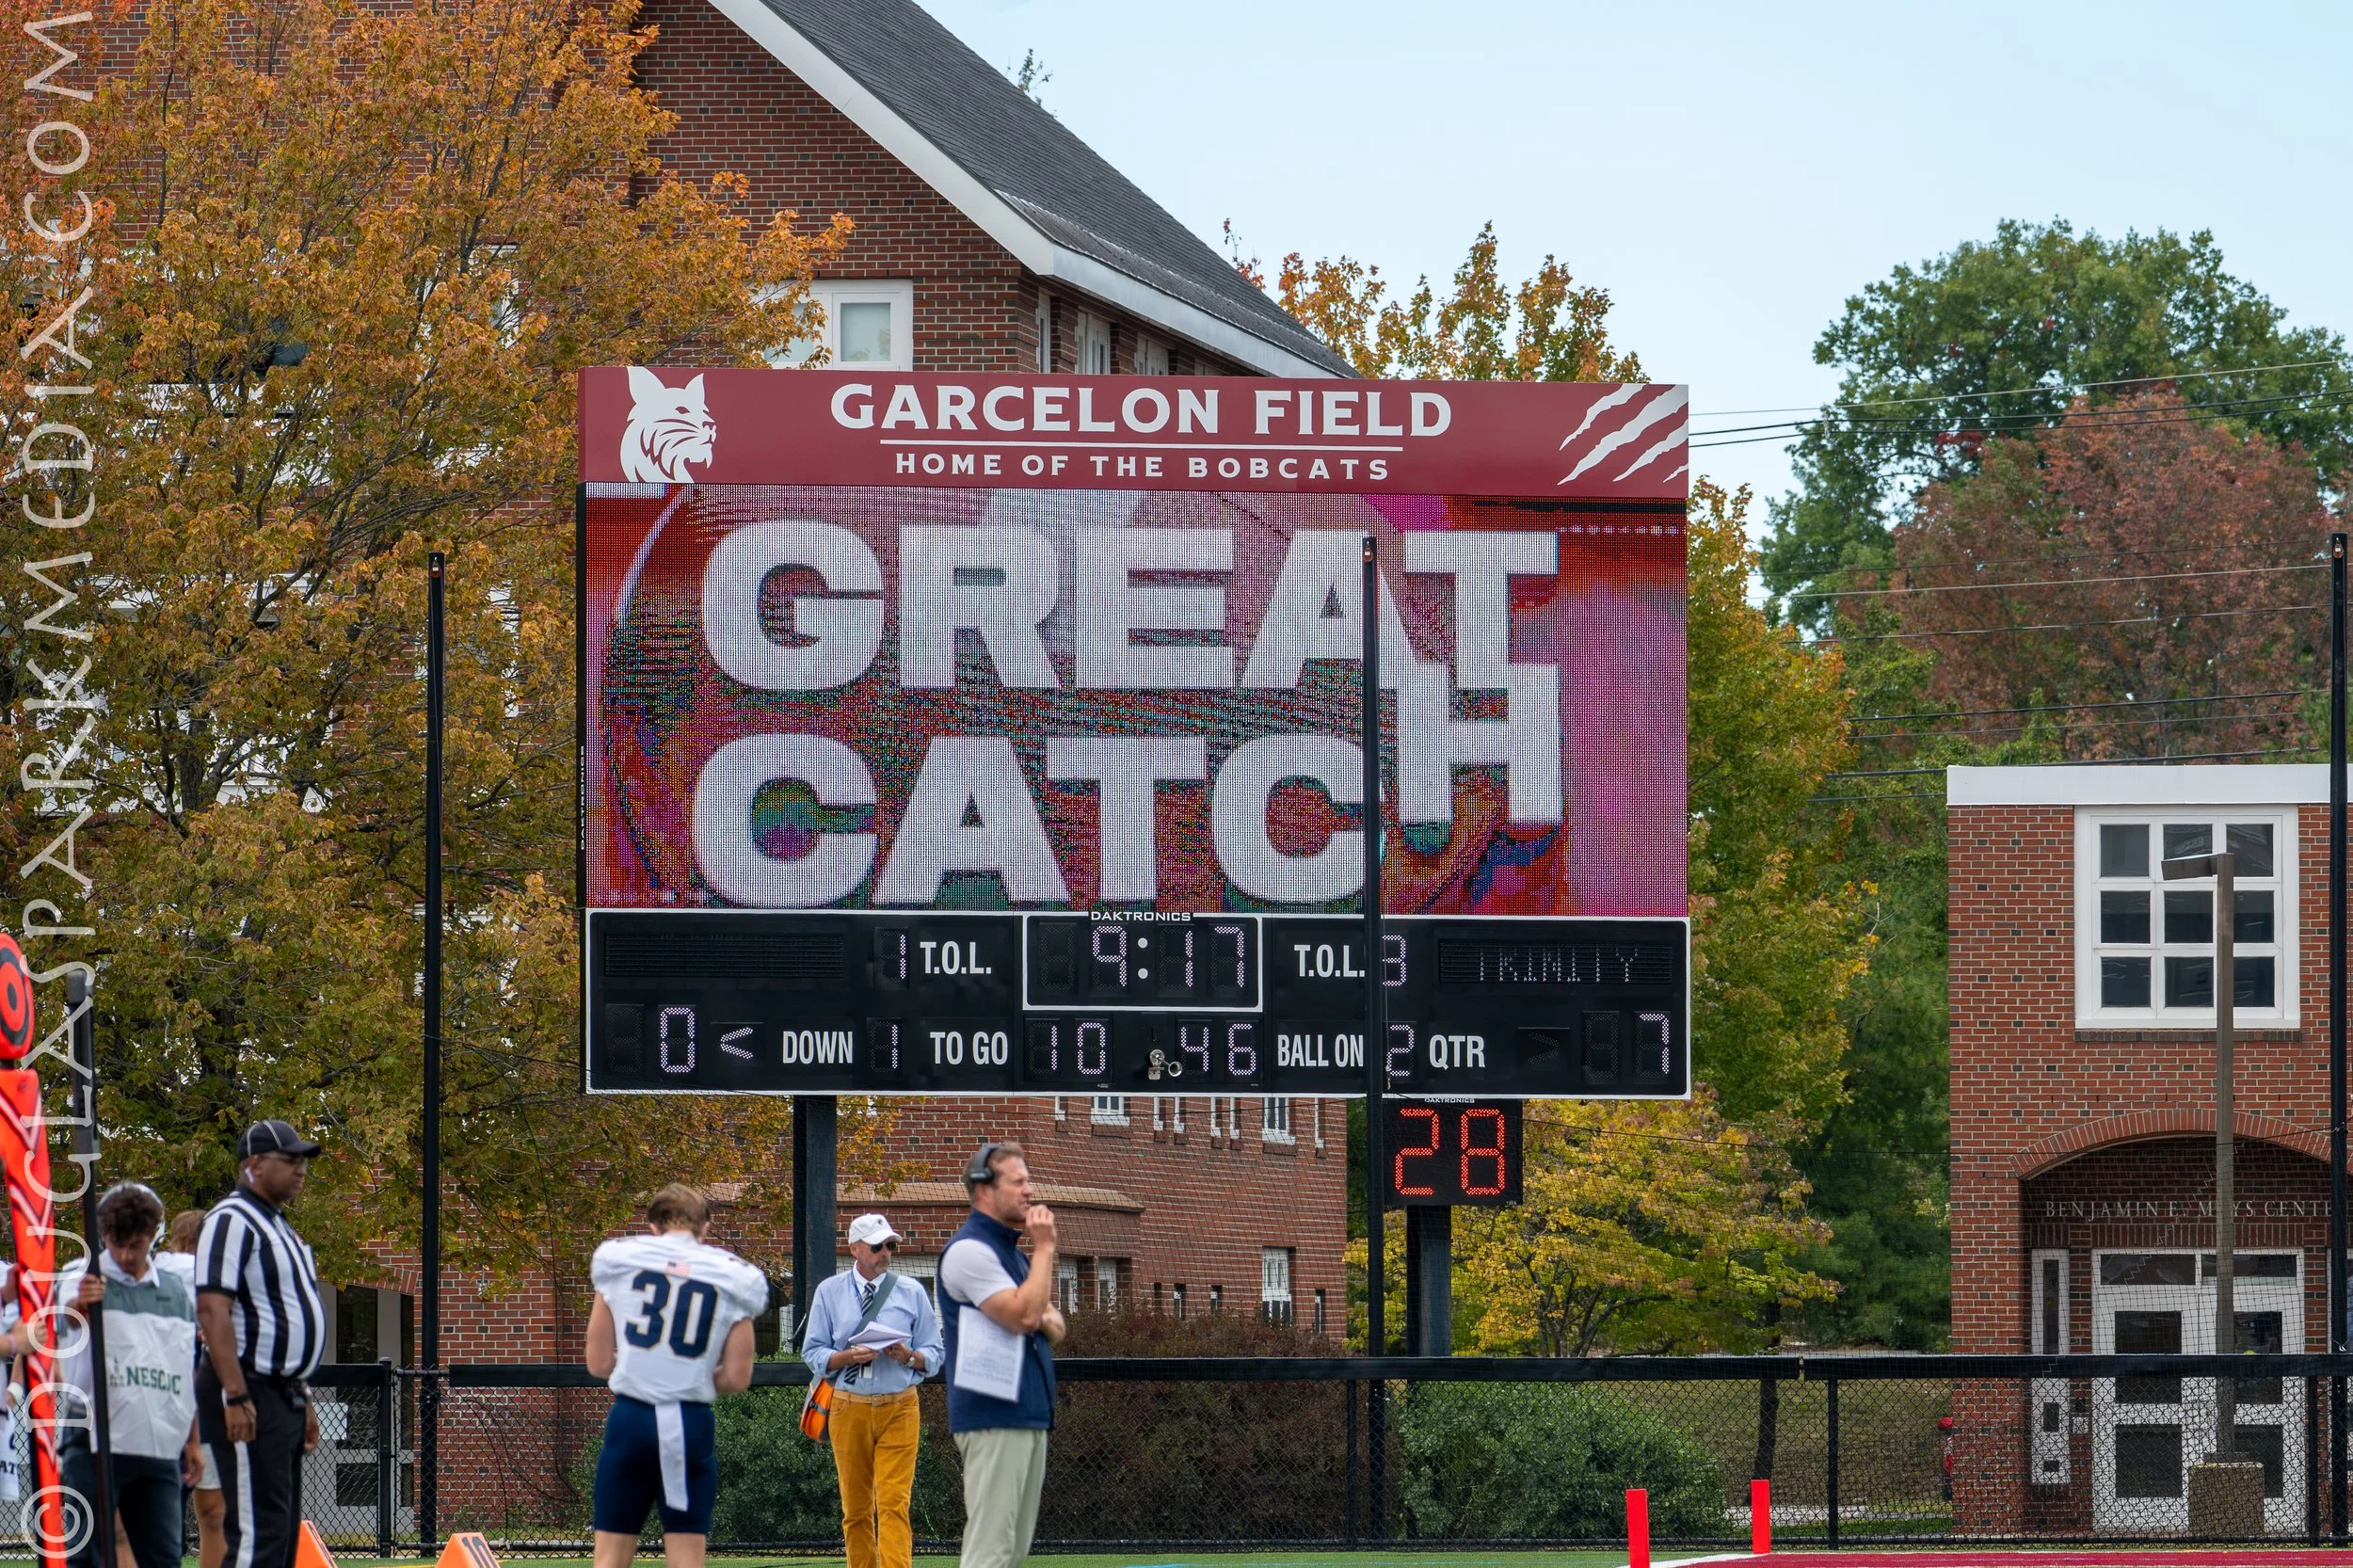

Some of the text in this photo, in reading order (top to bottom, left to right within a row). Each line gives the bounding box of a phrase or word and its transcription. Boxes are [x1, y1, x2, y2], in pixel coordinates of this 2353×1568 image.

[830, 383, 1452, 438] GARCELON FIELD
[895, 452, 1389, 481] HOME OF THE BOBCATS
[701, 520, 1560, 692] GREAT
[691, 663, 1564, 909] CATCH
[1091, 910, 1193, 922] DAKTRONICS
[920, 941, 992, 974] T.O.L.
[1092, 925, 1244, 988] 9:17
[1293, 944, 1365, 978] T.O.L.
[1382, 935, 1407, 987] 3
[660, 1006, 696, 1073] 0
[782, 1030, 854, 1064] DOWN
[930, 1031, 1008, 1065] TO GO
[1050, 1022, 1107, 1075] 10
[1180, 1023, 1257, 1076] 46
[1277, 1033, 1364, 1068] BALL ON
[1385, 1024, 1415, 1077] 2
[1428, 1034, 1486, 1071] QTR
[1639, 1013, 1671, 1075] 7
[1394, 1108, 1506, 1195] 28
[2045, 1200, 2158, 1222] BENJAMIN
[2198, 1200, 2254, 1218] MYS
[624, 1269, 718, 1359] 30
